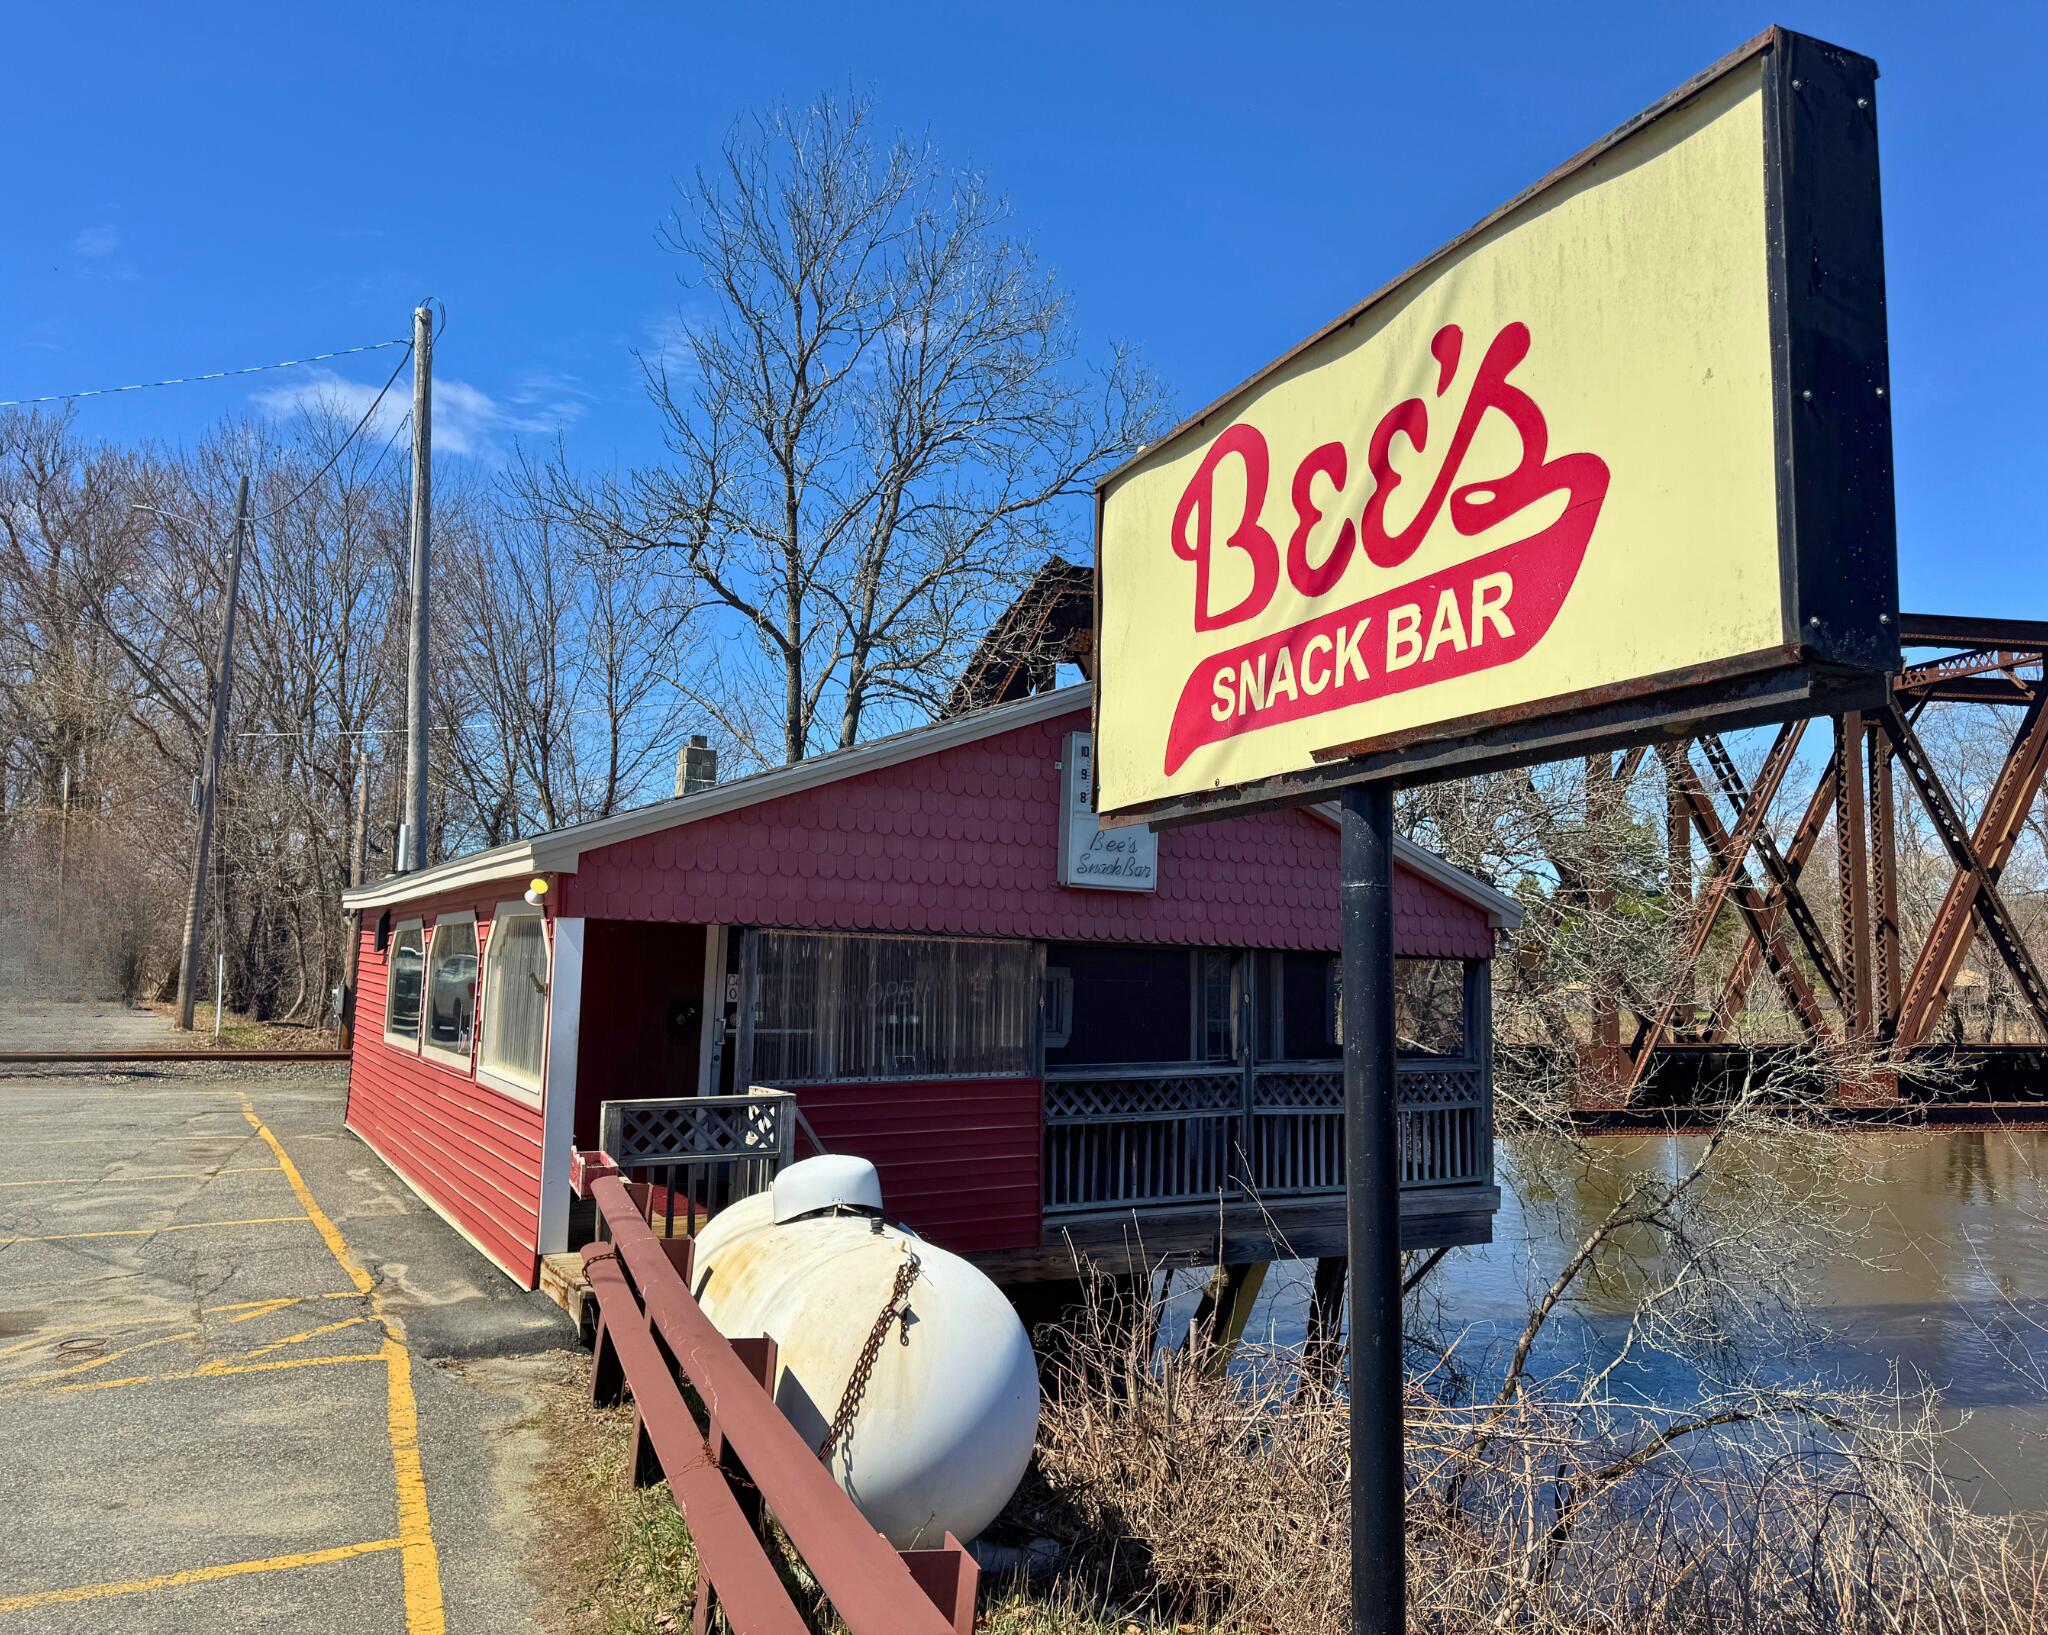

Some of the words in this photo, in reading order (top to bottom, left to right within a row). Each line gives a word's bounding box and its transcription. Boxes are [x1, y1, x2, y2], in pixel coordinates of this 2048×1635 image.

[1210, 617, 1372, 722] SNACK
[1387, 571, 1516, 674] BAR
[1081, 769, 1087, 780] 9
[1080, 792, 1087, 803] 8
[1090, 831, 1138, 854] Bee's
[1077, 853, 1122, 875] Snack
[1122, 857, 1151, 879] Bar
[866, 979, 930, 1008] OPEN
